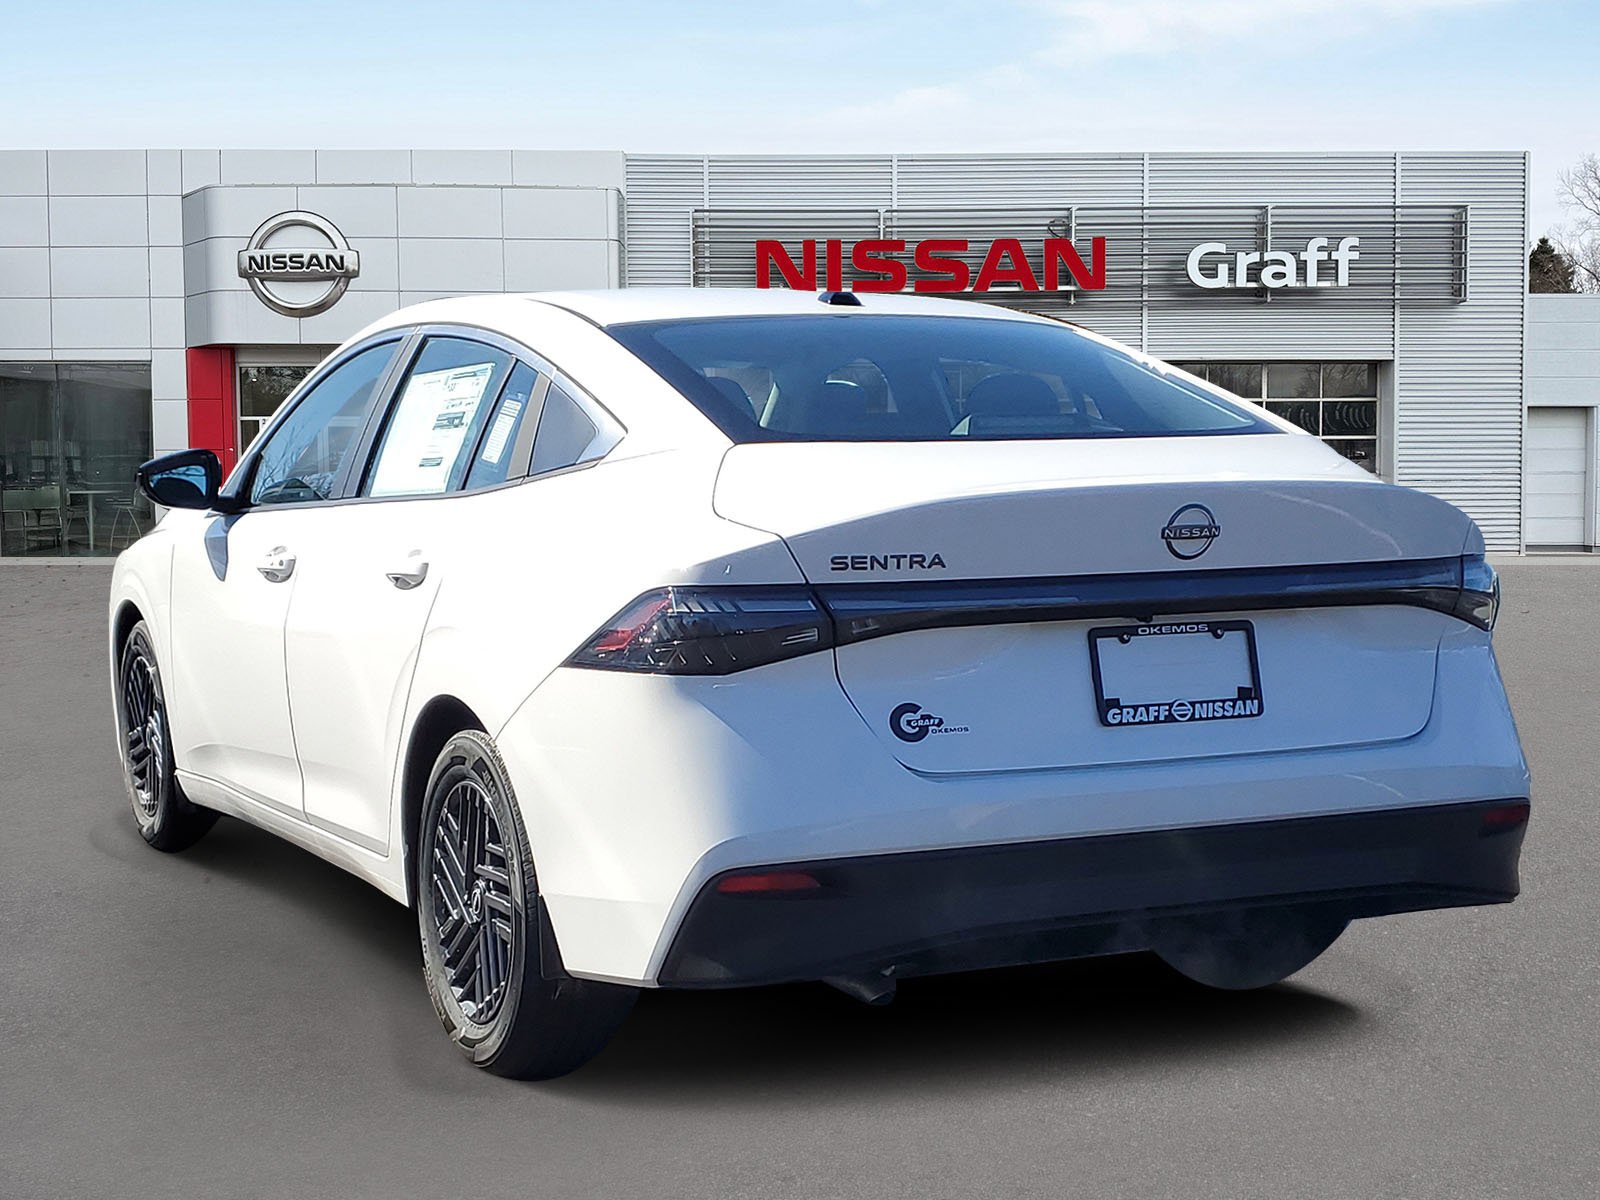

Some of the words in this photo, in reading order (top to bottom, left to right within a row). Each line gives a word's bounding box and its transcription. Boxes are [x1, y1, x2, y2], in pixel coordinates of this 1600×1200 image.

[248, 253, 345, 271] NISSAN
[756, 237, 1106, 293] NISSAN
[1187, 237, 1360, 288] Graff
[1164, 527, 1220, 538] NISSAN
[830, 553, 946, 571] SENTRA
[1137, 624, 1209, 635] OKEMOS
[1107, 706, 1169, 724] GRAFF
[1195, 699, 1259, 719] NISSAN
[931, 726, 969, 735] OKEMOS
